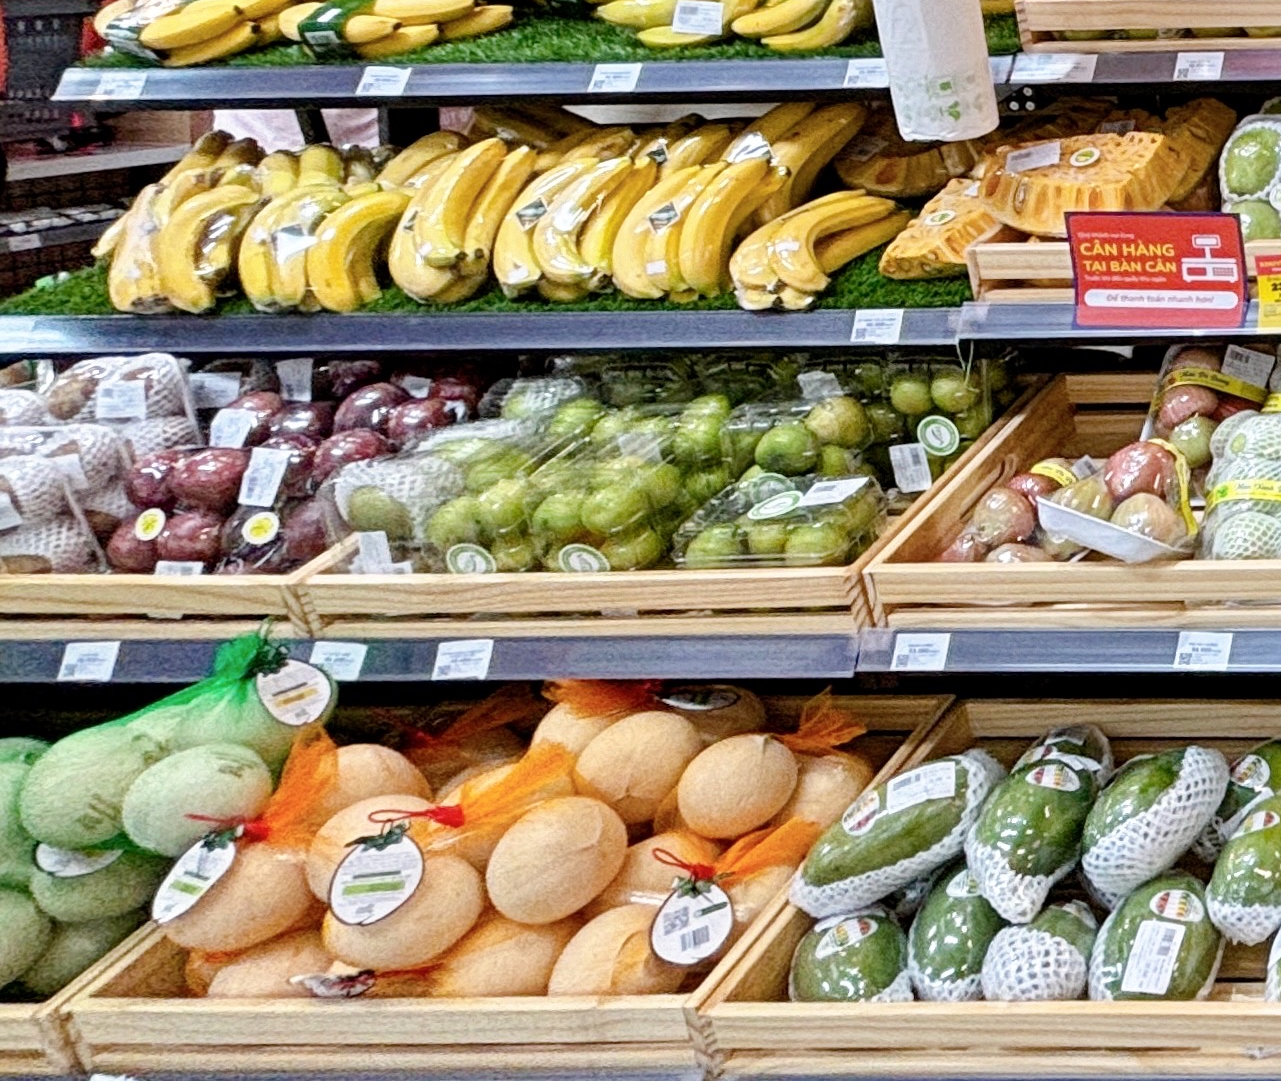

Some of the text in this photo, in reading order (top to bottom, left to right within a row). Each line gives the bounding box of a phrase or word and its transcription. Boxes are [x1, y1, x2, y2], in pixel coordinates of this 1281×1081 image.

[1080, 240, 1175, 257] CÂN HÀNG
[1082, 258, 1177, 274] TẠI BÀN CÂN
